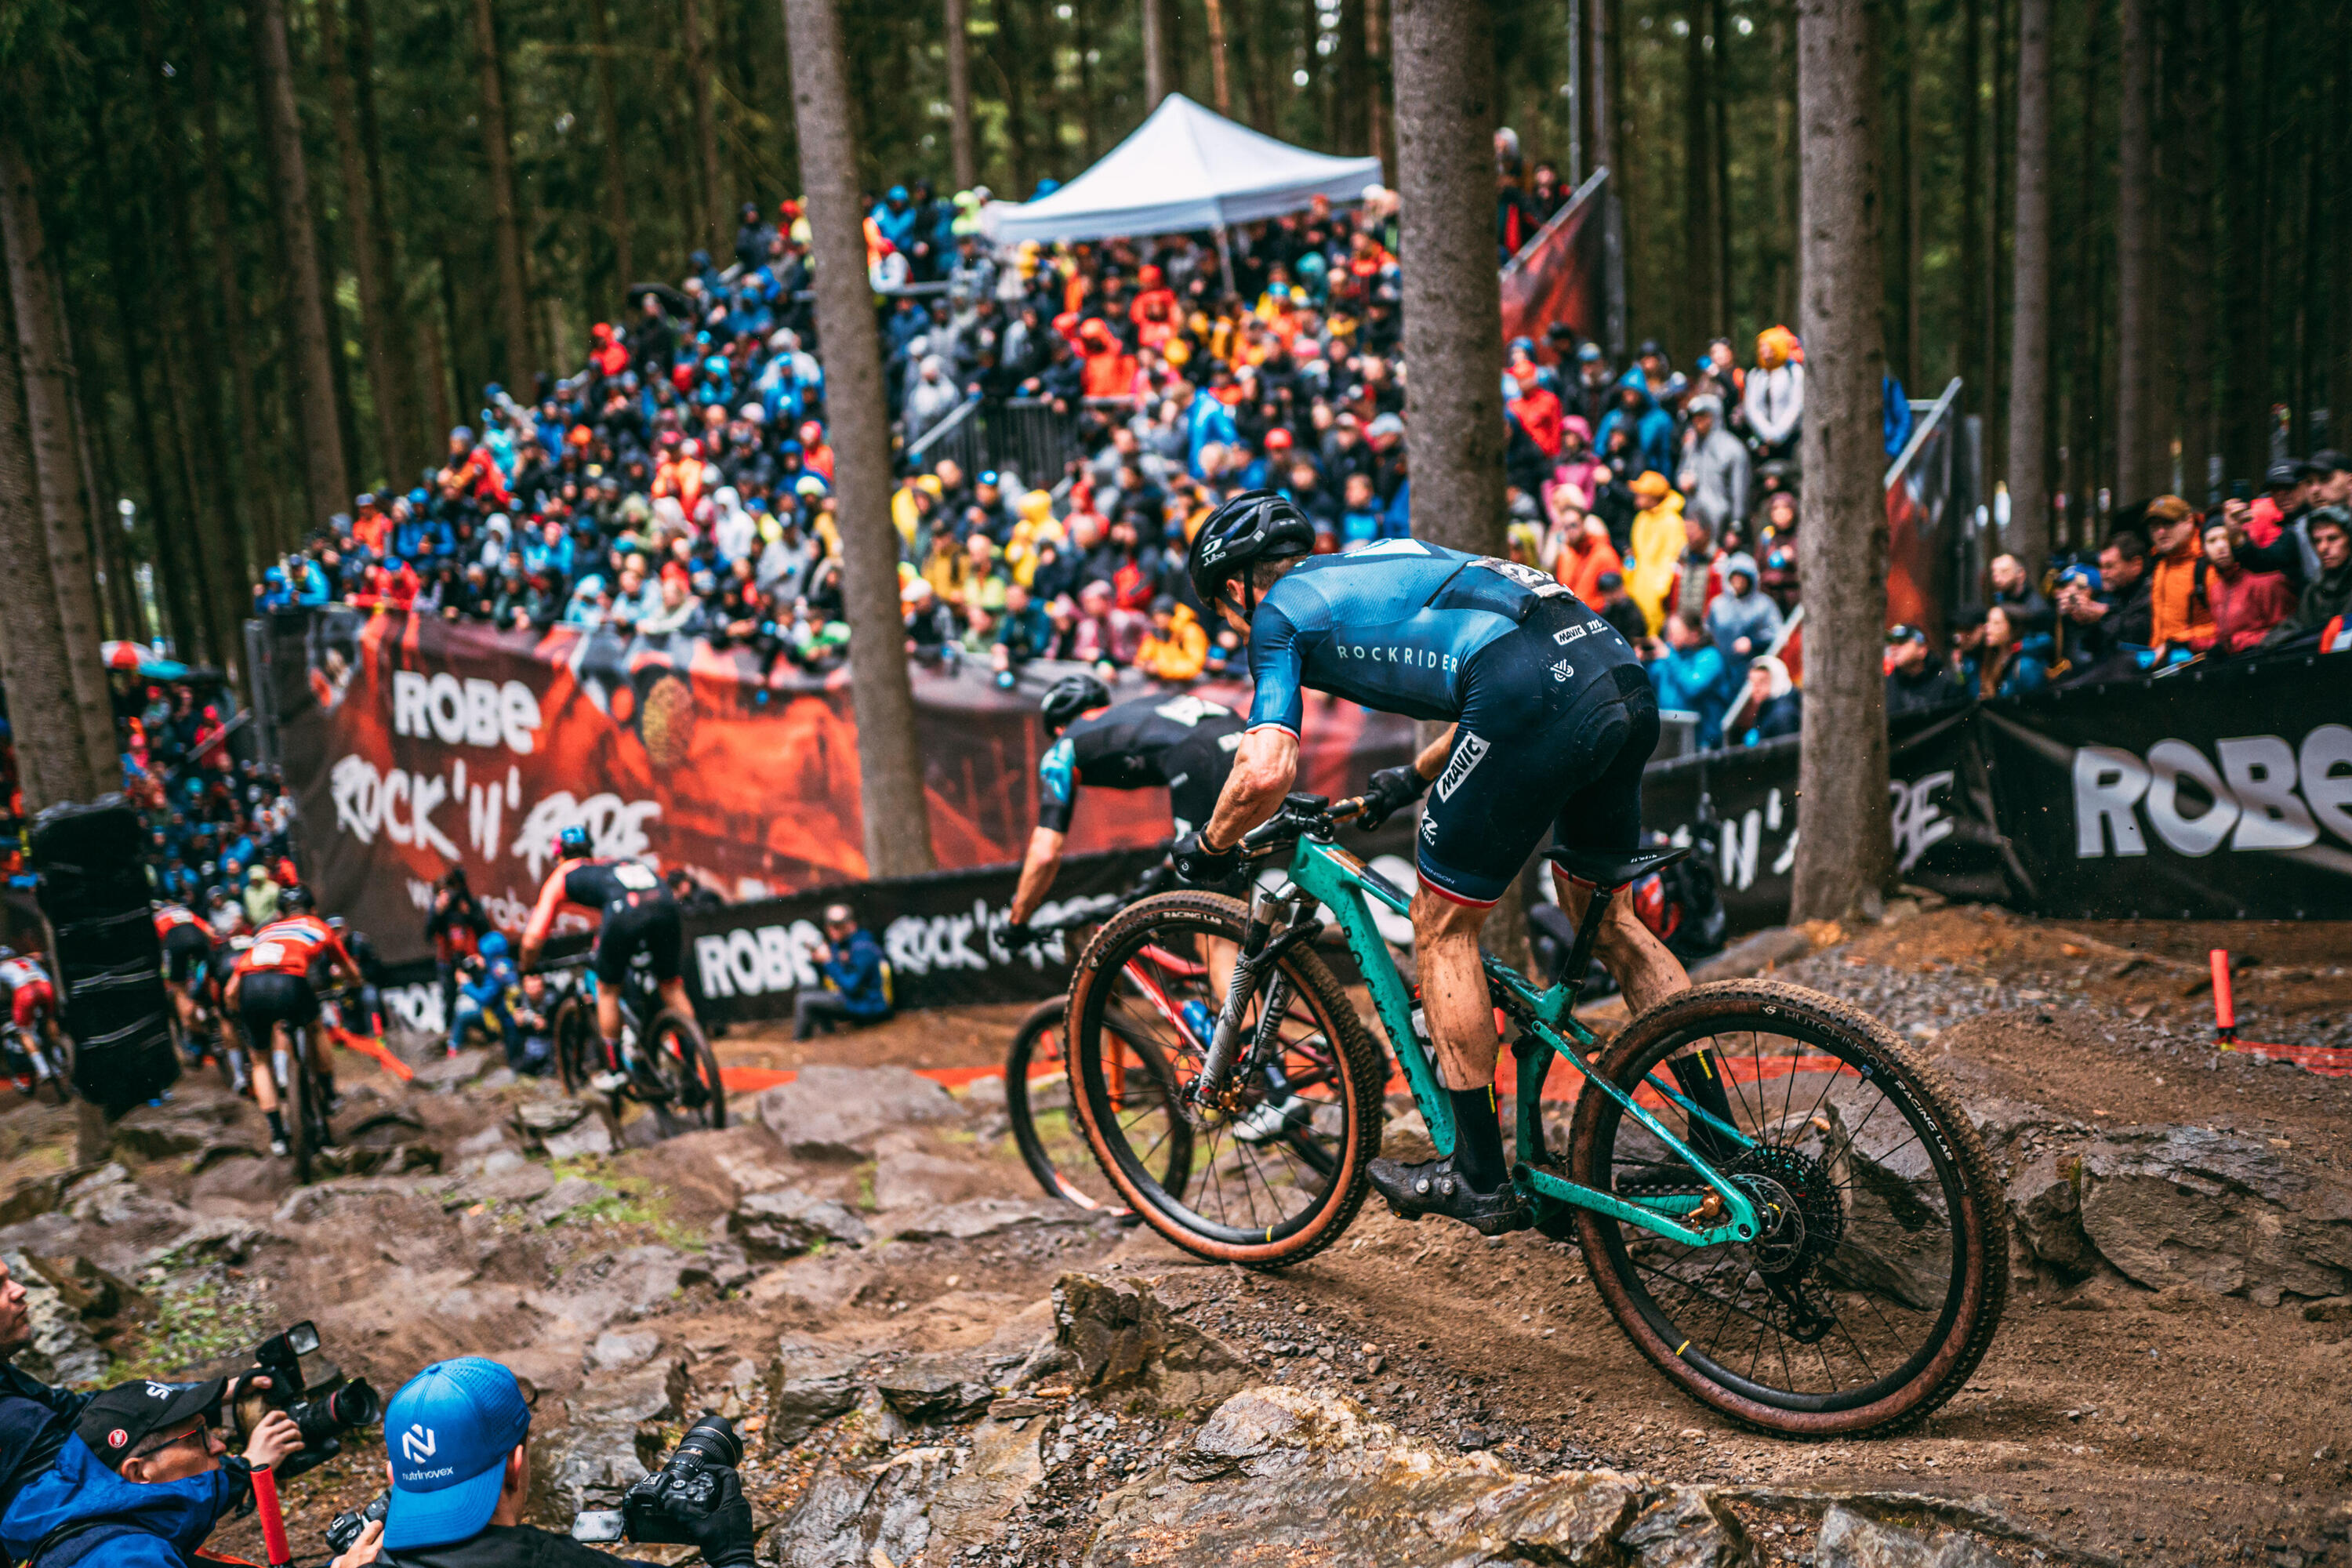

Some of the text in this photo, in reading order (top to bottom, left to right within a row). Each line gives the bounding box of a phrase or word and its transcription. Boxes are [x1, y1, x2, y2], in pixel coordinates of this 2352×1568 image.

[1203, 550, 1226, 566] Julbo
[1558, 626, 1583, 643] MAVIC
[1337, 645, 1458, 673] ROCKRIDER
[1441, 738, 1482, 797] MAVIC
[330, 753, 463, 862] ROCK
[1163, 911, 1202, 920] RACING
[1203, 913, 1222, 925] LAB
[884, 913, 989, 976] ROCK
[1784, 1010, 1954, 1162] HUTCHINSON RACING LAB
[402, 1466, 454, 1481] nutrinovex
